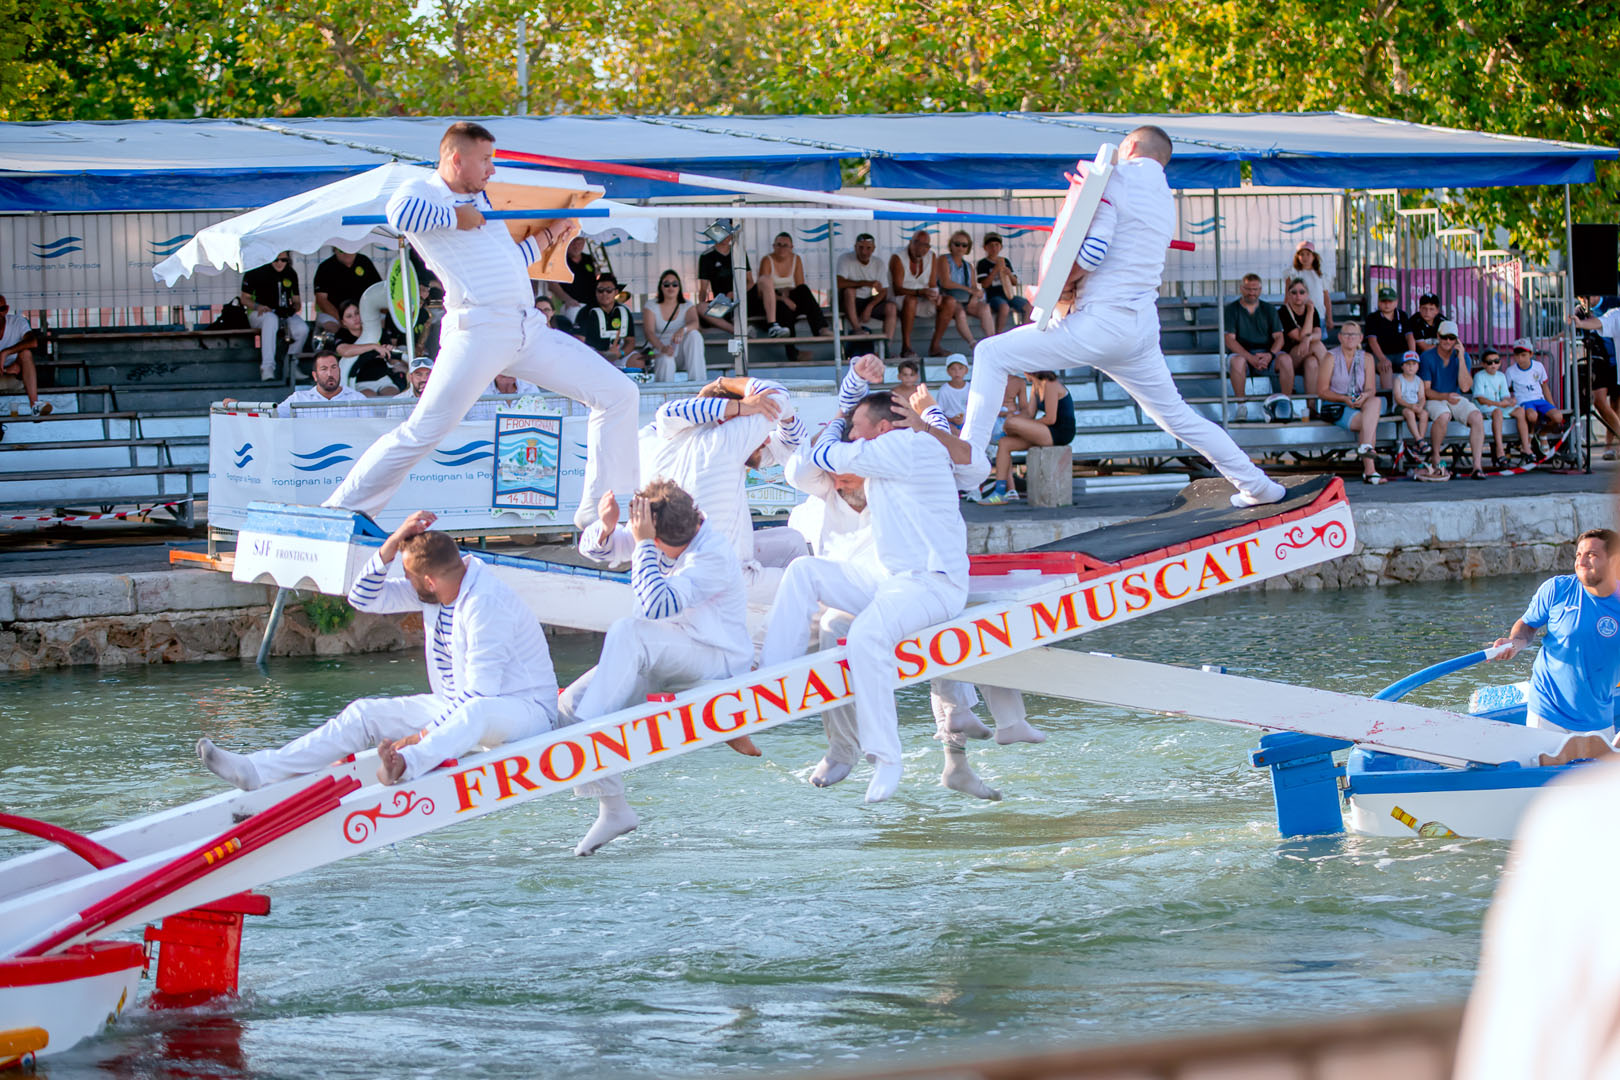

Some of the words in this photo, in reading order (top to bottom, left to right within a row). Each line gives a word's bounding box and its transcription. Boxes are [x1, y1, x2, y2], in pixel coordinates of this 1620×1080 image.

[506, 418, 554, 432] FRONTIGNAN
[323, 476, 332, 486] la
[409, 472, 462, 483] Frontignan
[465, 470, 474, 480] la
[507, 493, 519, 504] 14
[520, 492, 547, 505] JUILLET
[253, 539, 272, 557] SJF
[275, 549, 319, 562] FRONTIGNAN
[894, 611, 1014, 682] SON
[1028, 537, 1261, 641] MUSCAT
